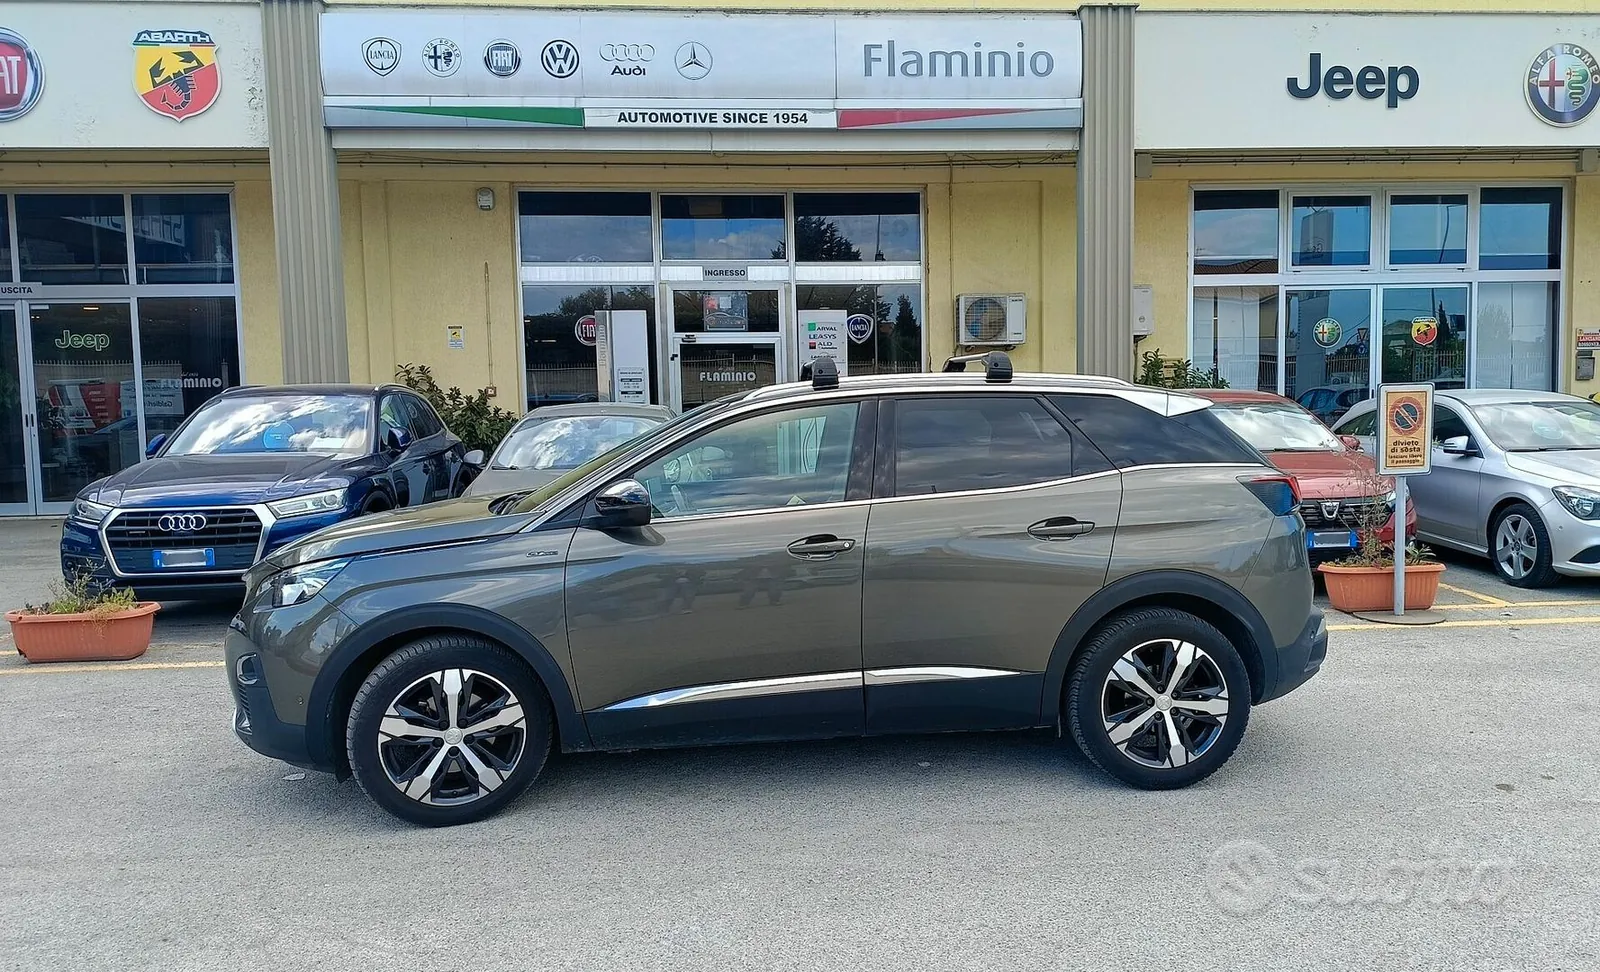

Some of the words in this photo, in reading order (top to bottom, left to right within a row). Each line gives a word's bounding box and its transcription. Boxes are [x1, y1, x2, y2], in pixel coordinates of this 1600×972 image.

[138, 32, 211, 43] ABARTH
[369, 52, 395, 60] LANCIA
[863, 40, 1055, 78] Flaminio
[610, 64, 647, 77] Audi
[1529, 50, 1554, 86] ALFA
[1563, 45, 1600, 86] ROMEO
[1287, 53, 1420, 108] Jeep
[617, 112, 718, 124] AUTOMOTIVE
[722, 112, 769, 124] SINCE
[773, 112, 808, 124] 1954
[705, 269, 746, 277] INGRESSO
[1, 286, 33, 295] USCITA
[582, 324, 597, 338] FIA
[55, 330, 110, 351] Jeep
[700, 371, 756, 382] FLAMINIO
